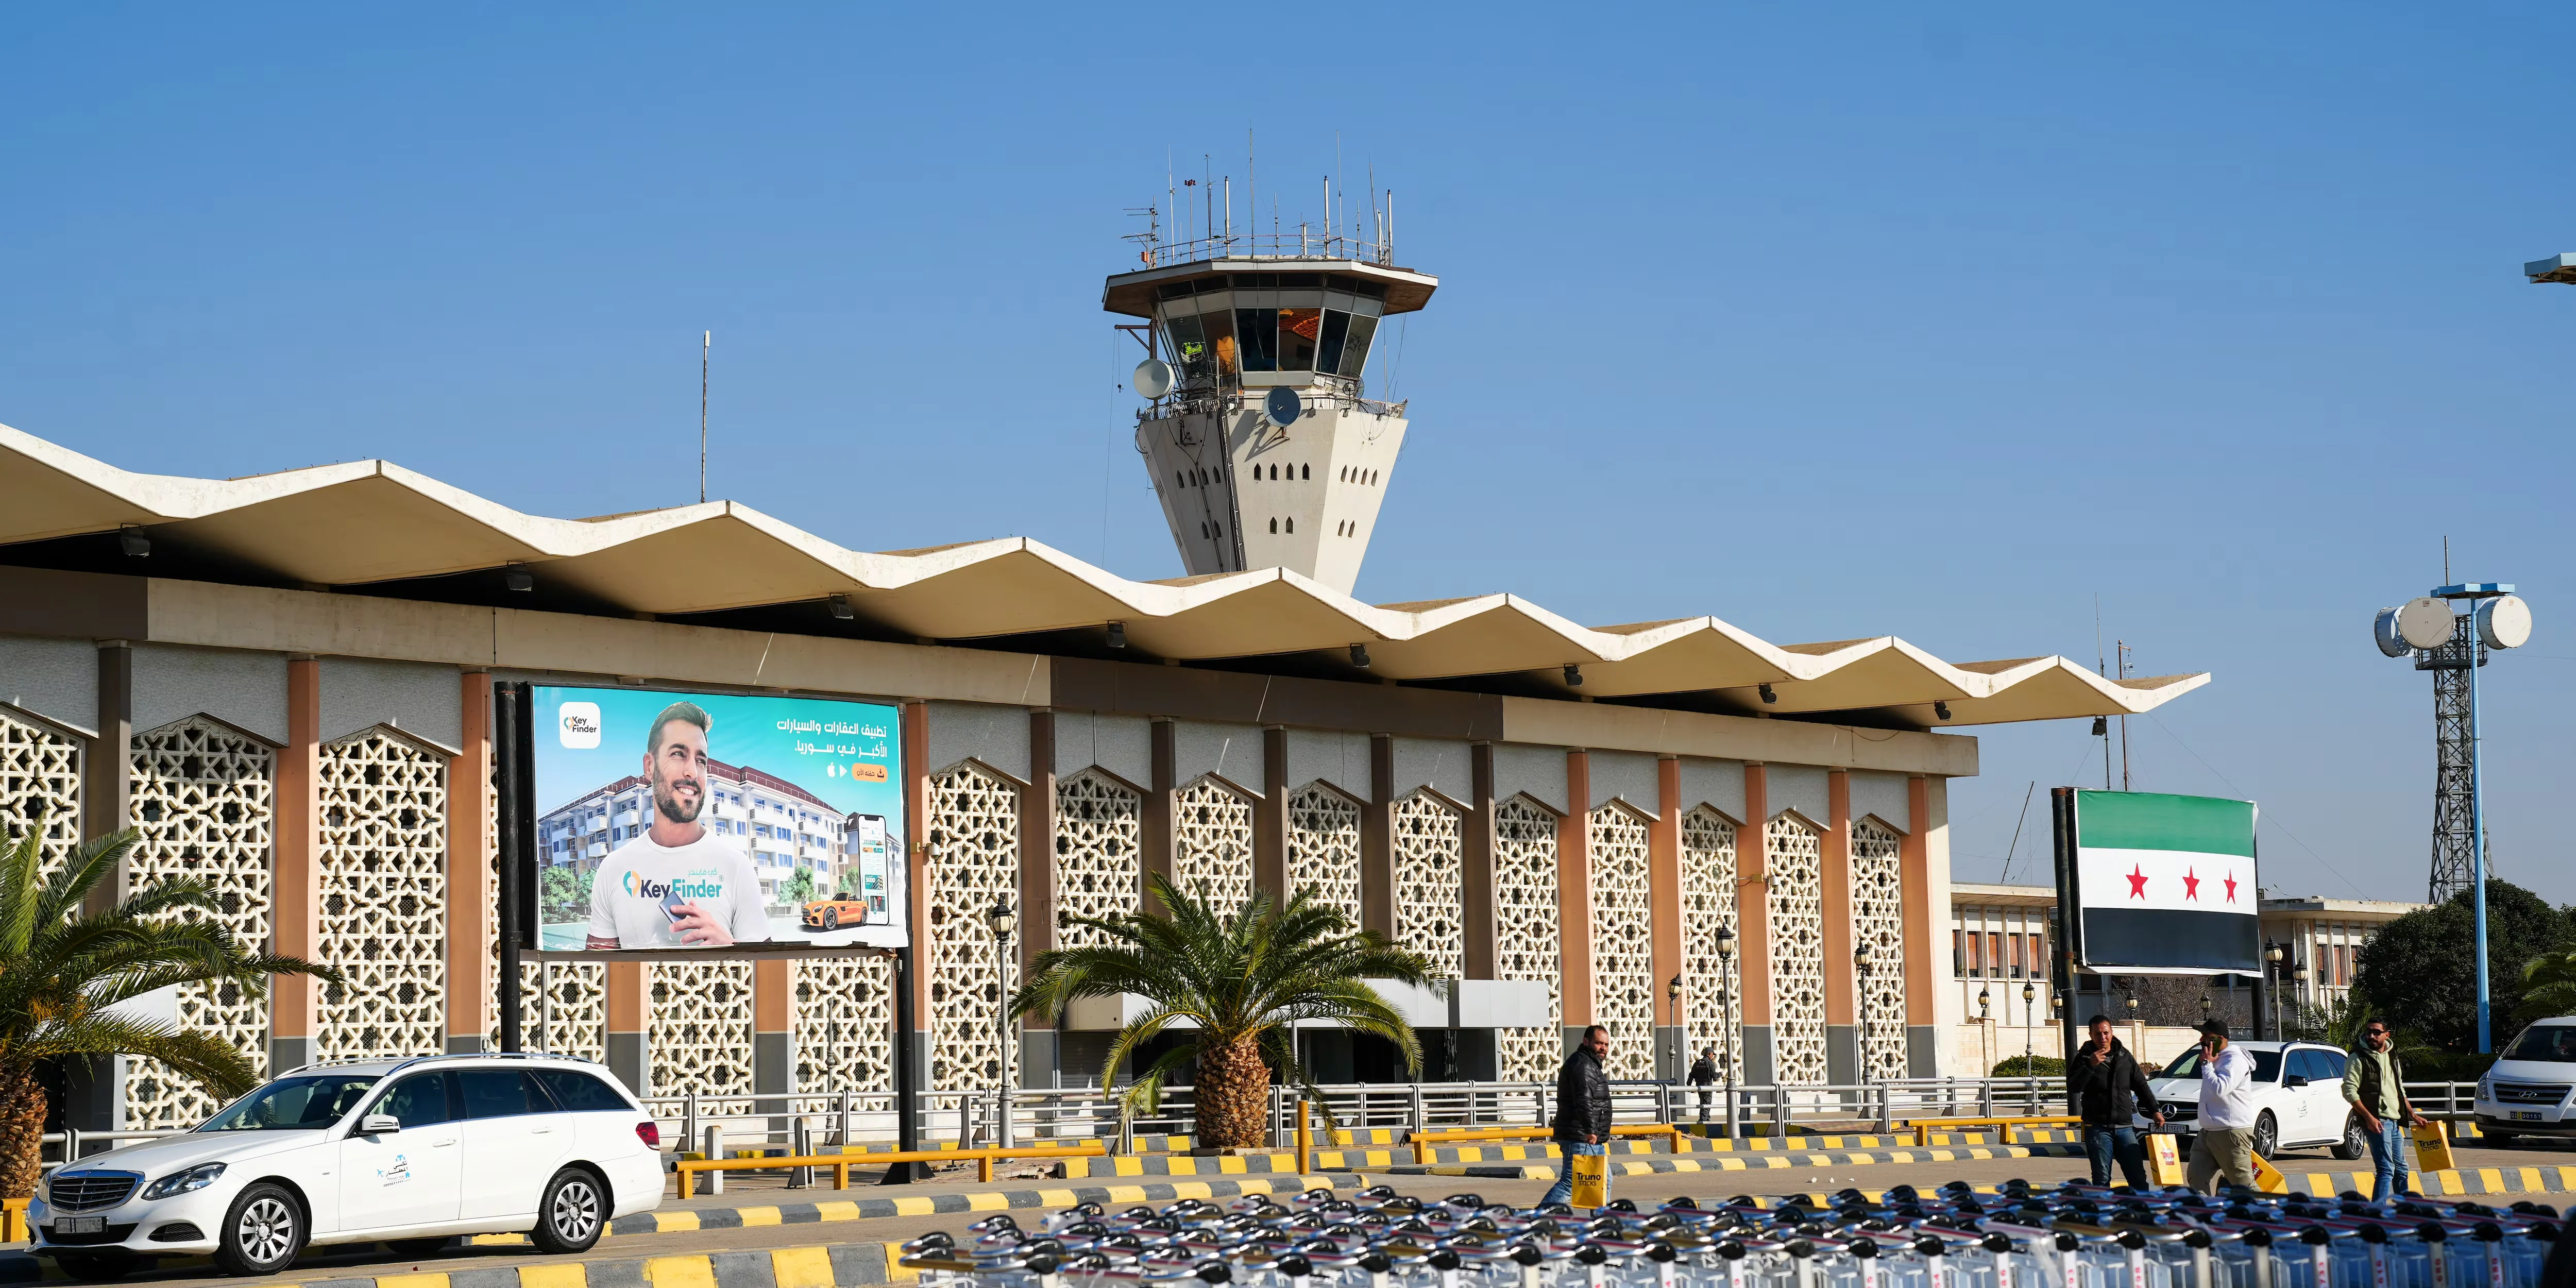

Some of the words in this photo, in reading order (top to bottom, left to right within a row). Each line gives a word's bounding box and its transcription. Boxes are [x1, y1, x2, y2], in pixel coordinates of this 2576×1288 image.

[572, 716, 587, 725] Key
[572, 724, 597, 733] Finder
[776, 719, 821, 735] والسيارات
[824, 721, 858, 736] العقارات
[861, 724, 887, 739] تطبيق
[838, 743, 856, 756] في
[858, 741, 887, 759] الأكبر
[688, 868, 707, 877] فايندر
[707, 867, 717, 877] كي
[2417, 1139, 2441, 1147] Truno
[394, 1161, 407, 1171] تكسي
[386, 1166, 408, 1177] المطار
[1576, 1172, 1601, 1181] Truno
